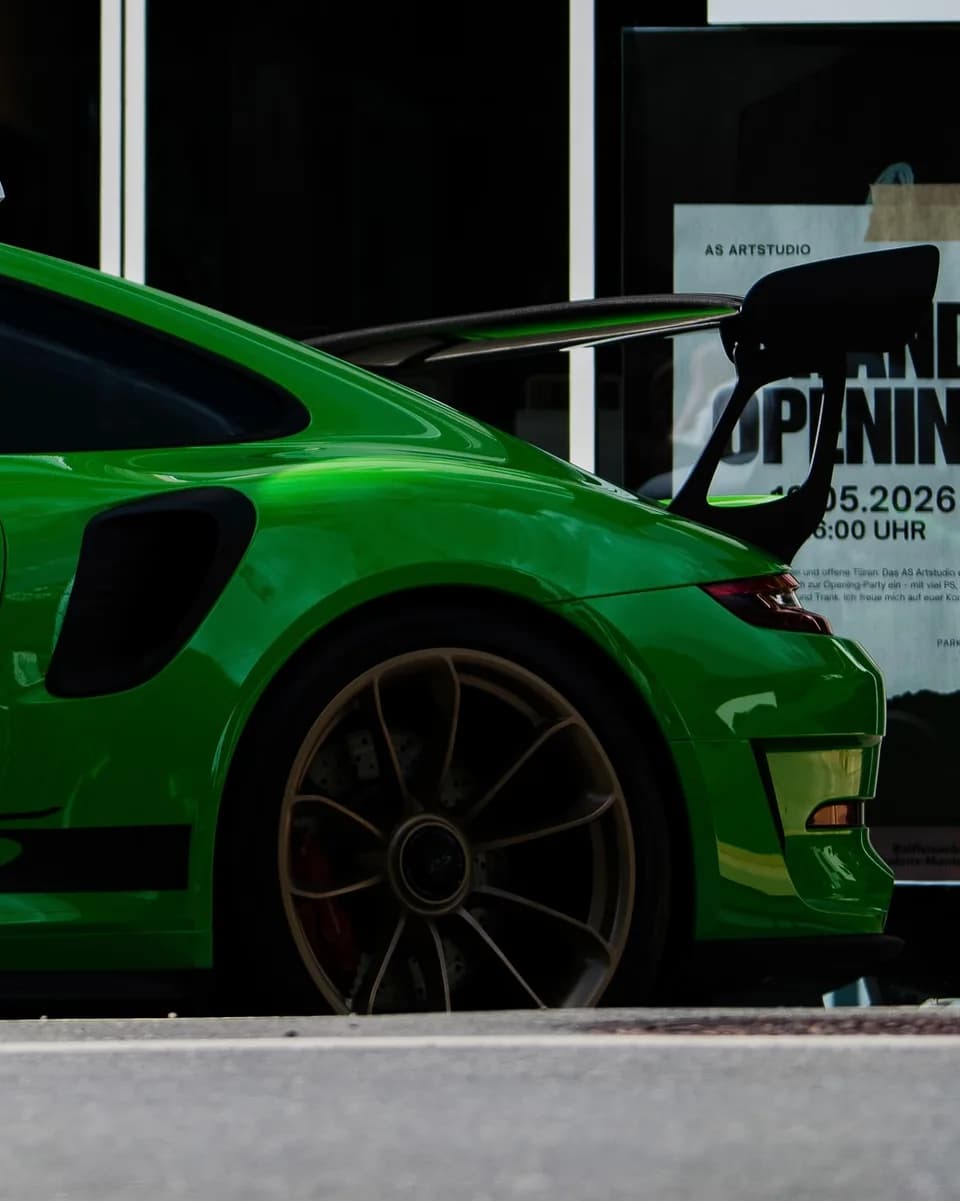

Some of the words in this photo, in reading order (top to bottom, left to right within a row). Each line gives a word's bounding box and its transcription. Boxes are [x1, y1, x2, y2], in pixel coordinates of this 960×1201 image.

[705, 244, 724, 256] AS
[729, 243, 812, 256] ARTSTUDIO
[771, 485, 956, 512] 05.2026
[813, 520, 865, 539] 6:00
[875, 520, 926, 539] UHR
[882, 569, 899, 577] Das
[902, 569, 914, 577] AS
